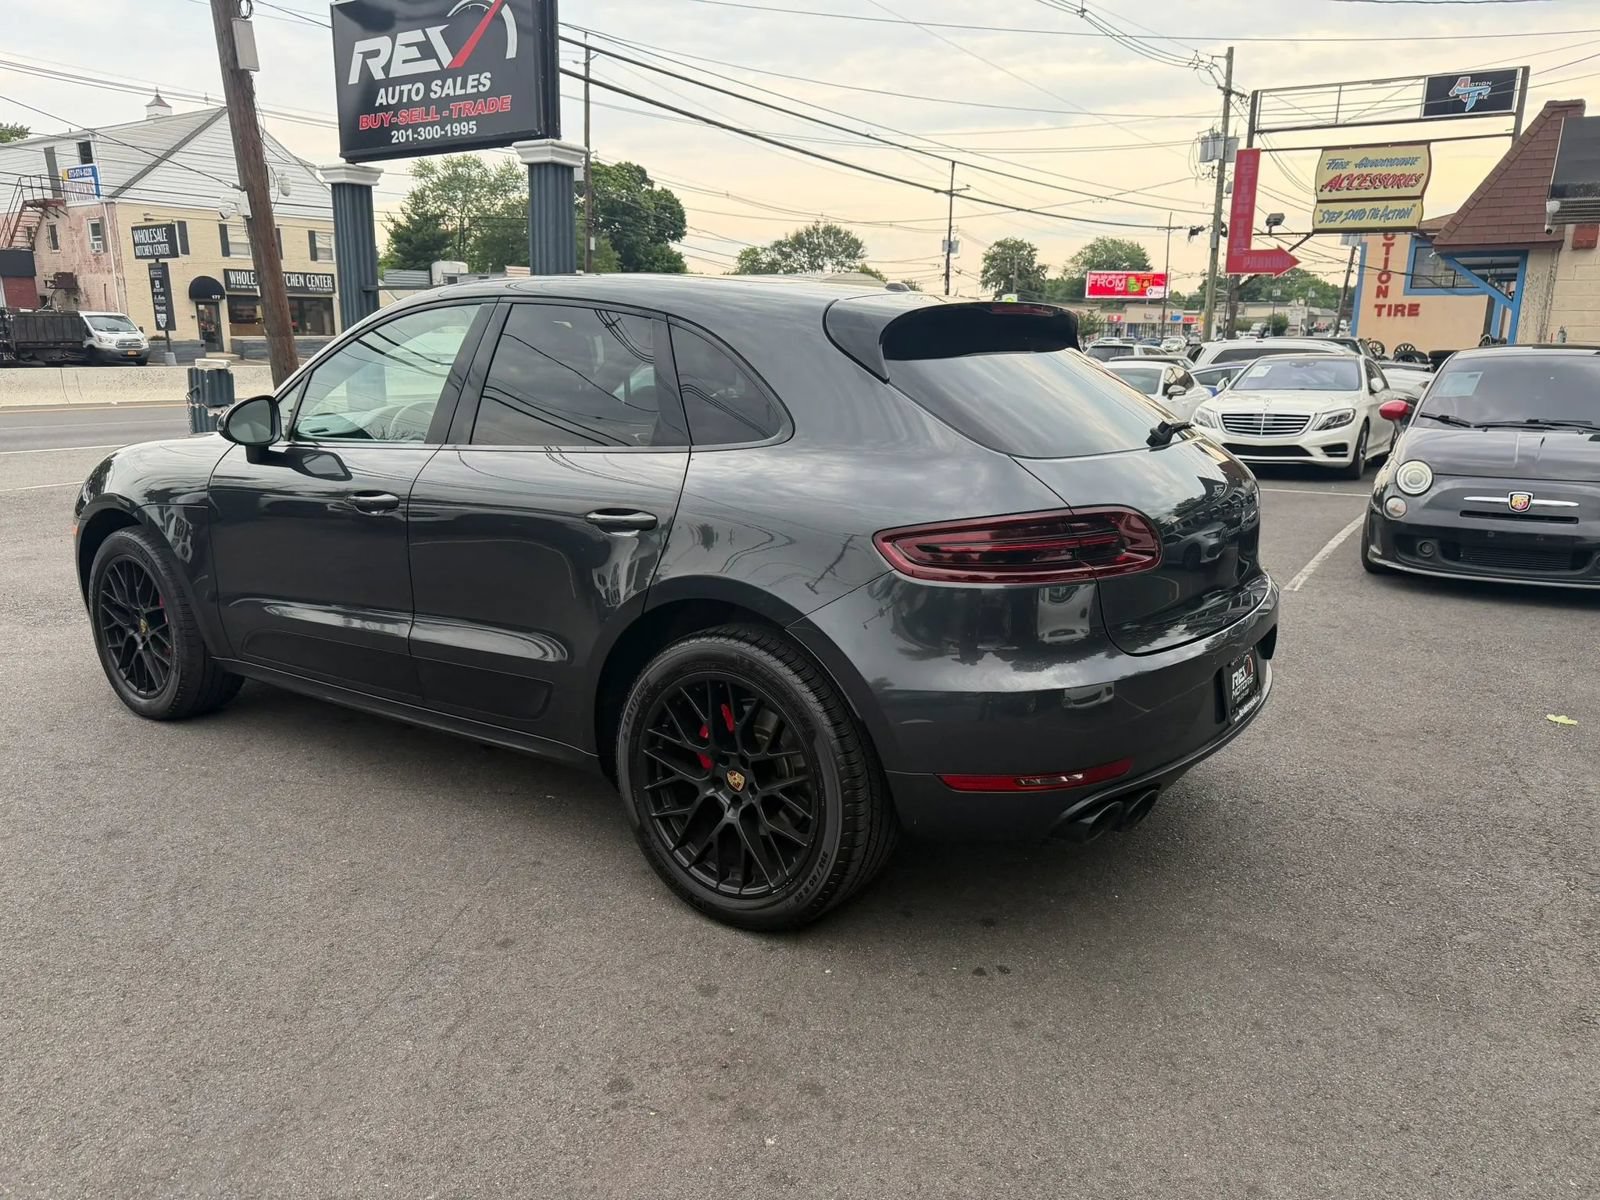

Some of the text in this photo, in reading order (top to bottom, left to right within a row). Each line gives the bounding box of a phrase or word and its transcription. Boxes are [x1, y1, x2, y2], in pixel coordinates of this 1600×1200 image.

[348, 0, 499, 84] REV
[375, 72, 491, 107] AUTO SALES
[391, 121, 477, 144] 201-300-1995
[1319, 173, 1424, 193] ACCESSORIES
[133, 227, 168, 243] WHOLESALE
[153, 243, 171, 256] CENTER
[228, 271, 257, 285] WHOLE
[306, 274, 333, 288] CENTER
[1089, 279, 1125, 287] FROM
[1374, 303, 1421, 317] TIRE
